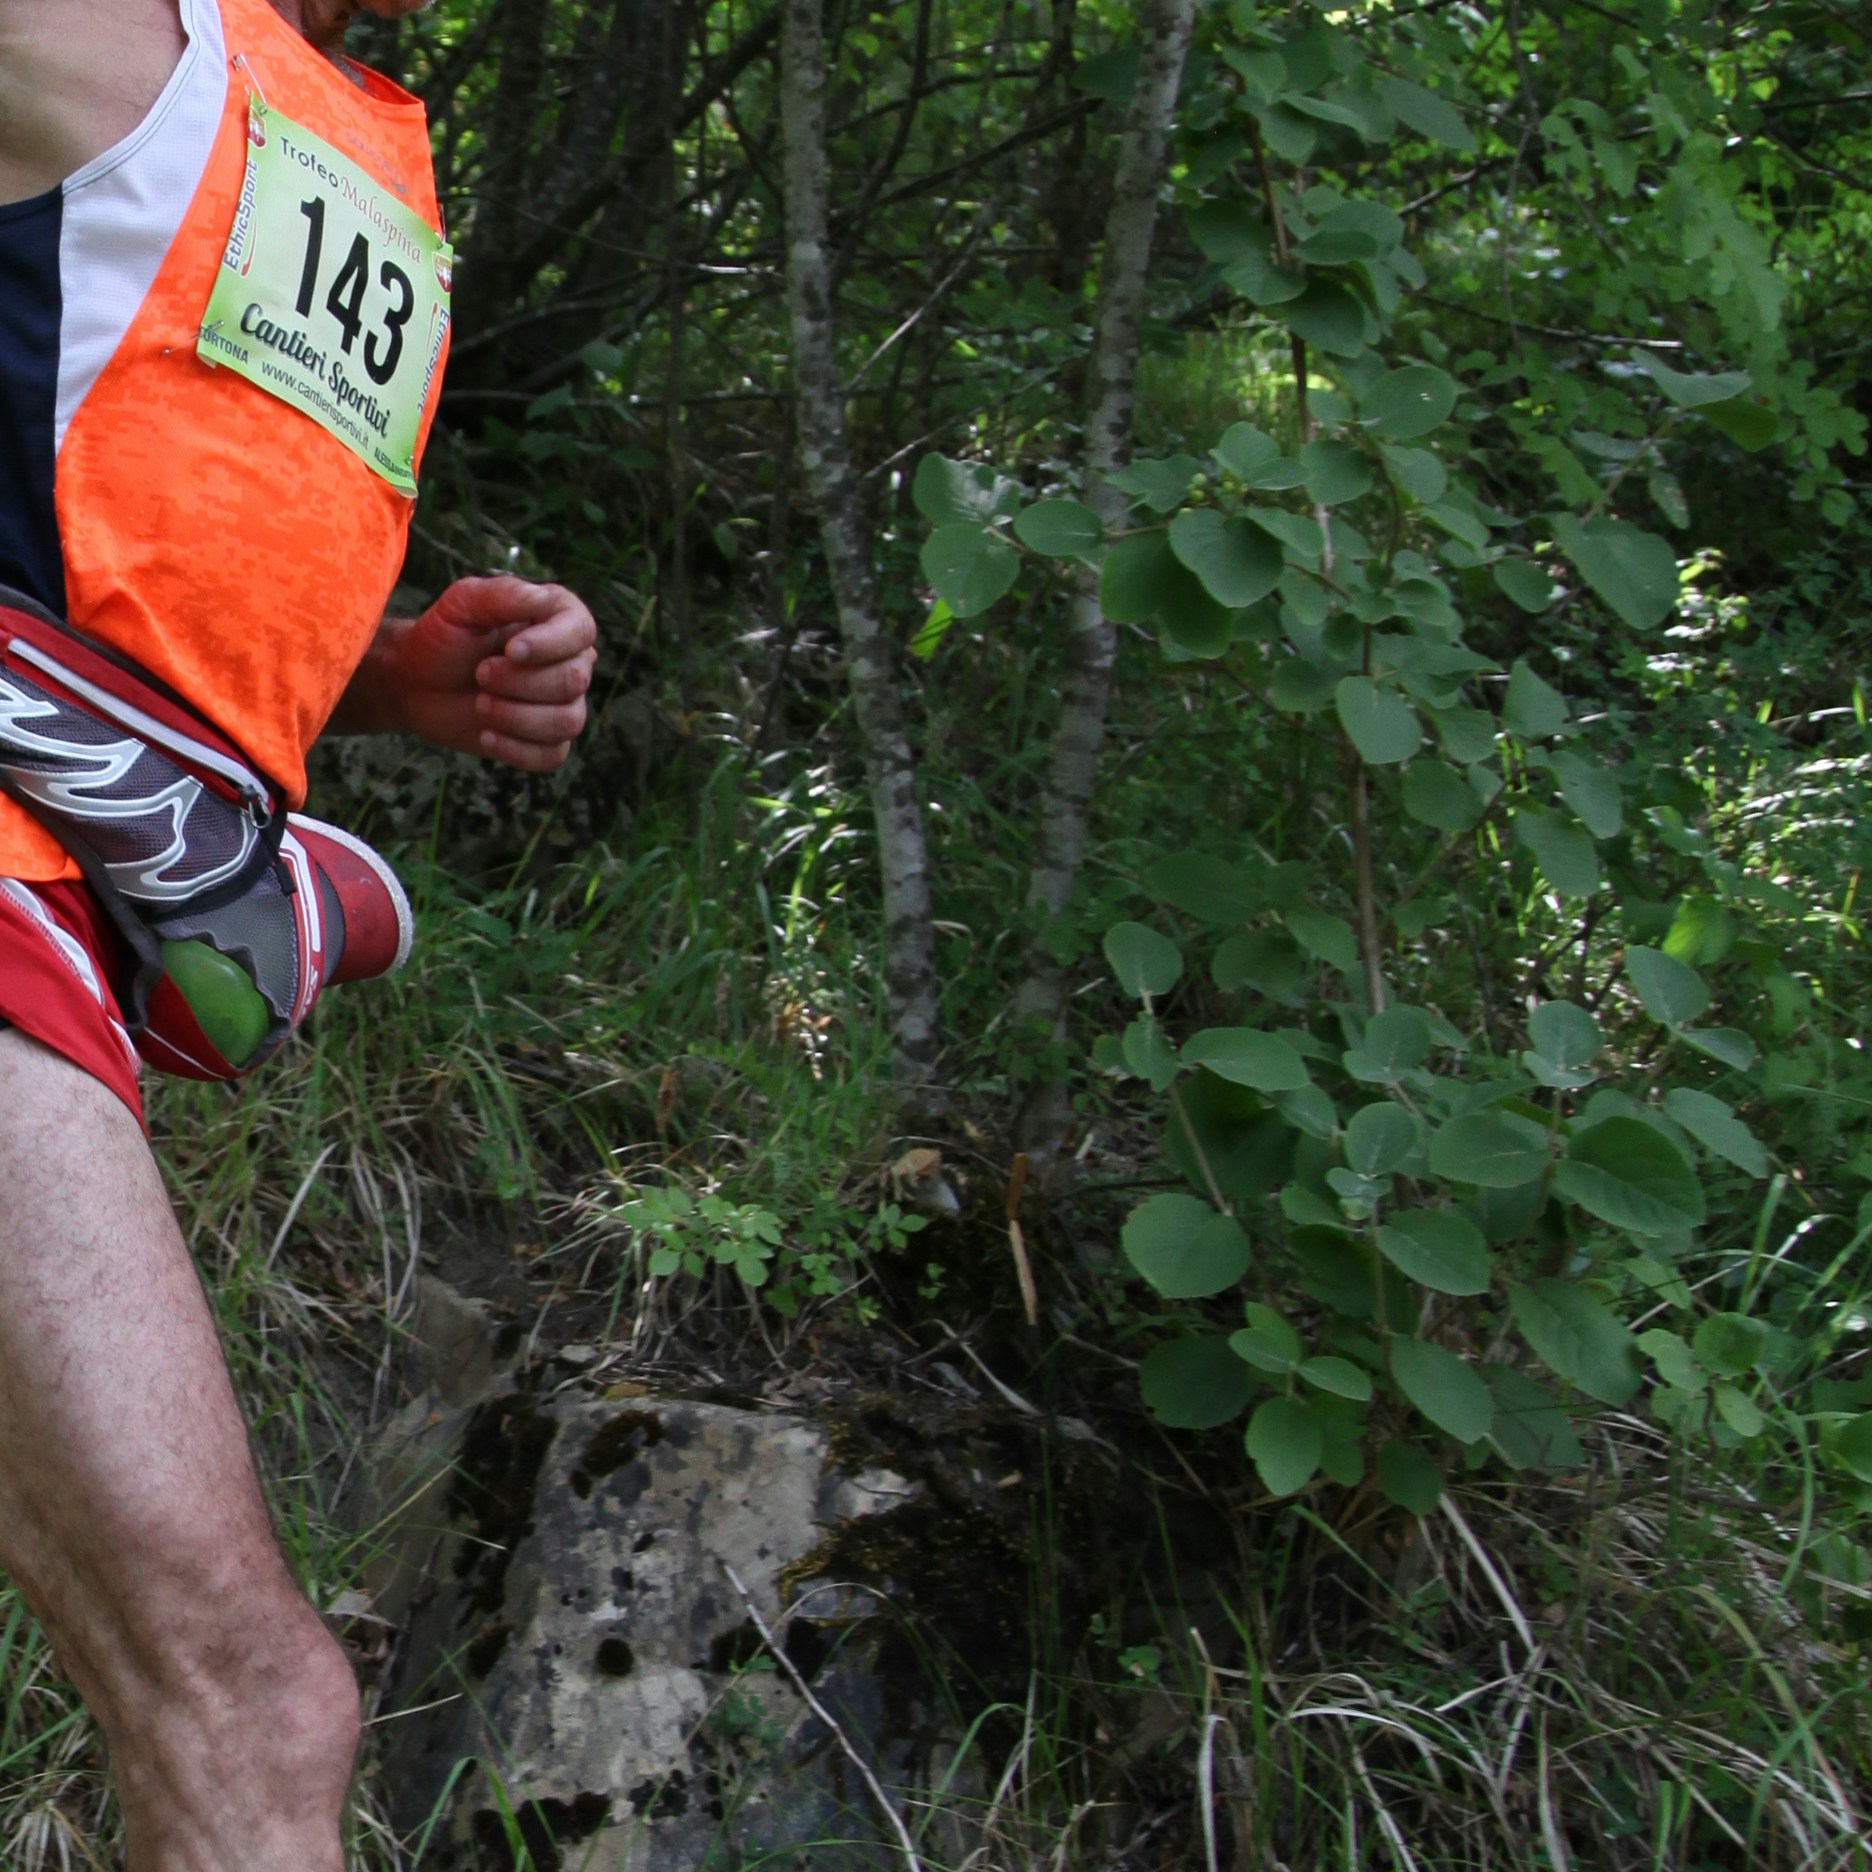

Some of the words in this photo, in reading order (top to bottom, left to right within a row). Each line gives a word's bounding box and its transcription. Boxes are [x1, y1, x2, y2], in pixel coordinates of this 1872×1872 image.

[223, 159, 257, 270] EthicSport
[280, 136, 339, 188] Trofeo
[340, 176, 421, 263] Malaspina
[295, 194, 414, 386] 143
[239, 302, 327, 380] Cantieri
[327, 360, 391, 439] Sportivi
[261, 360, 370, 451] www.cantierisportivi.it
